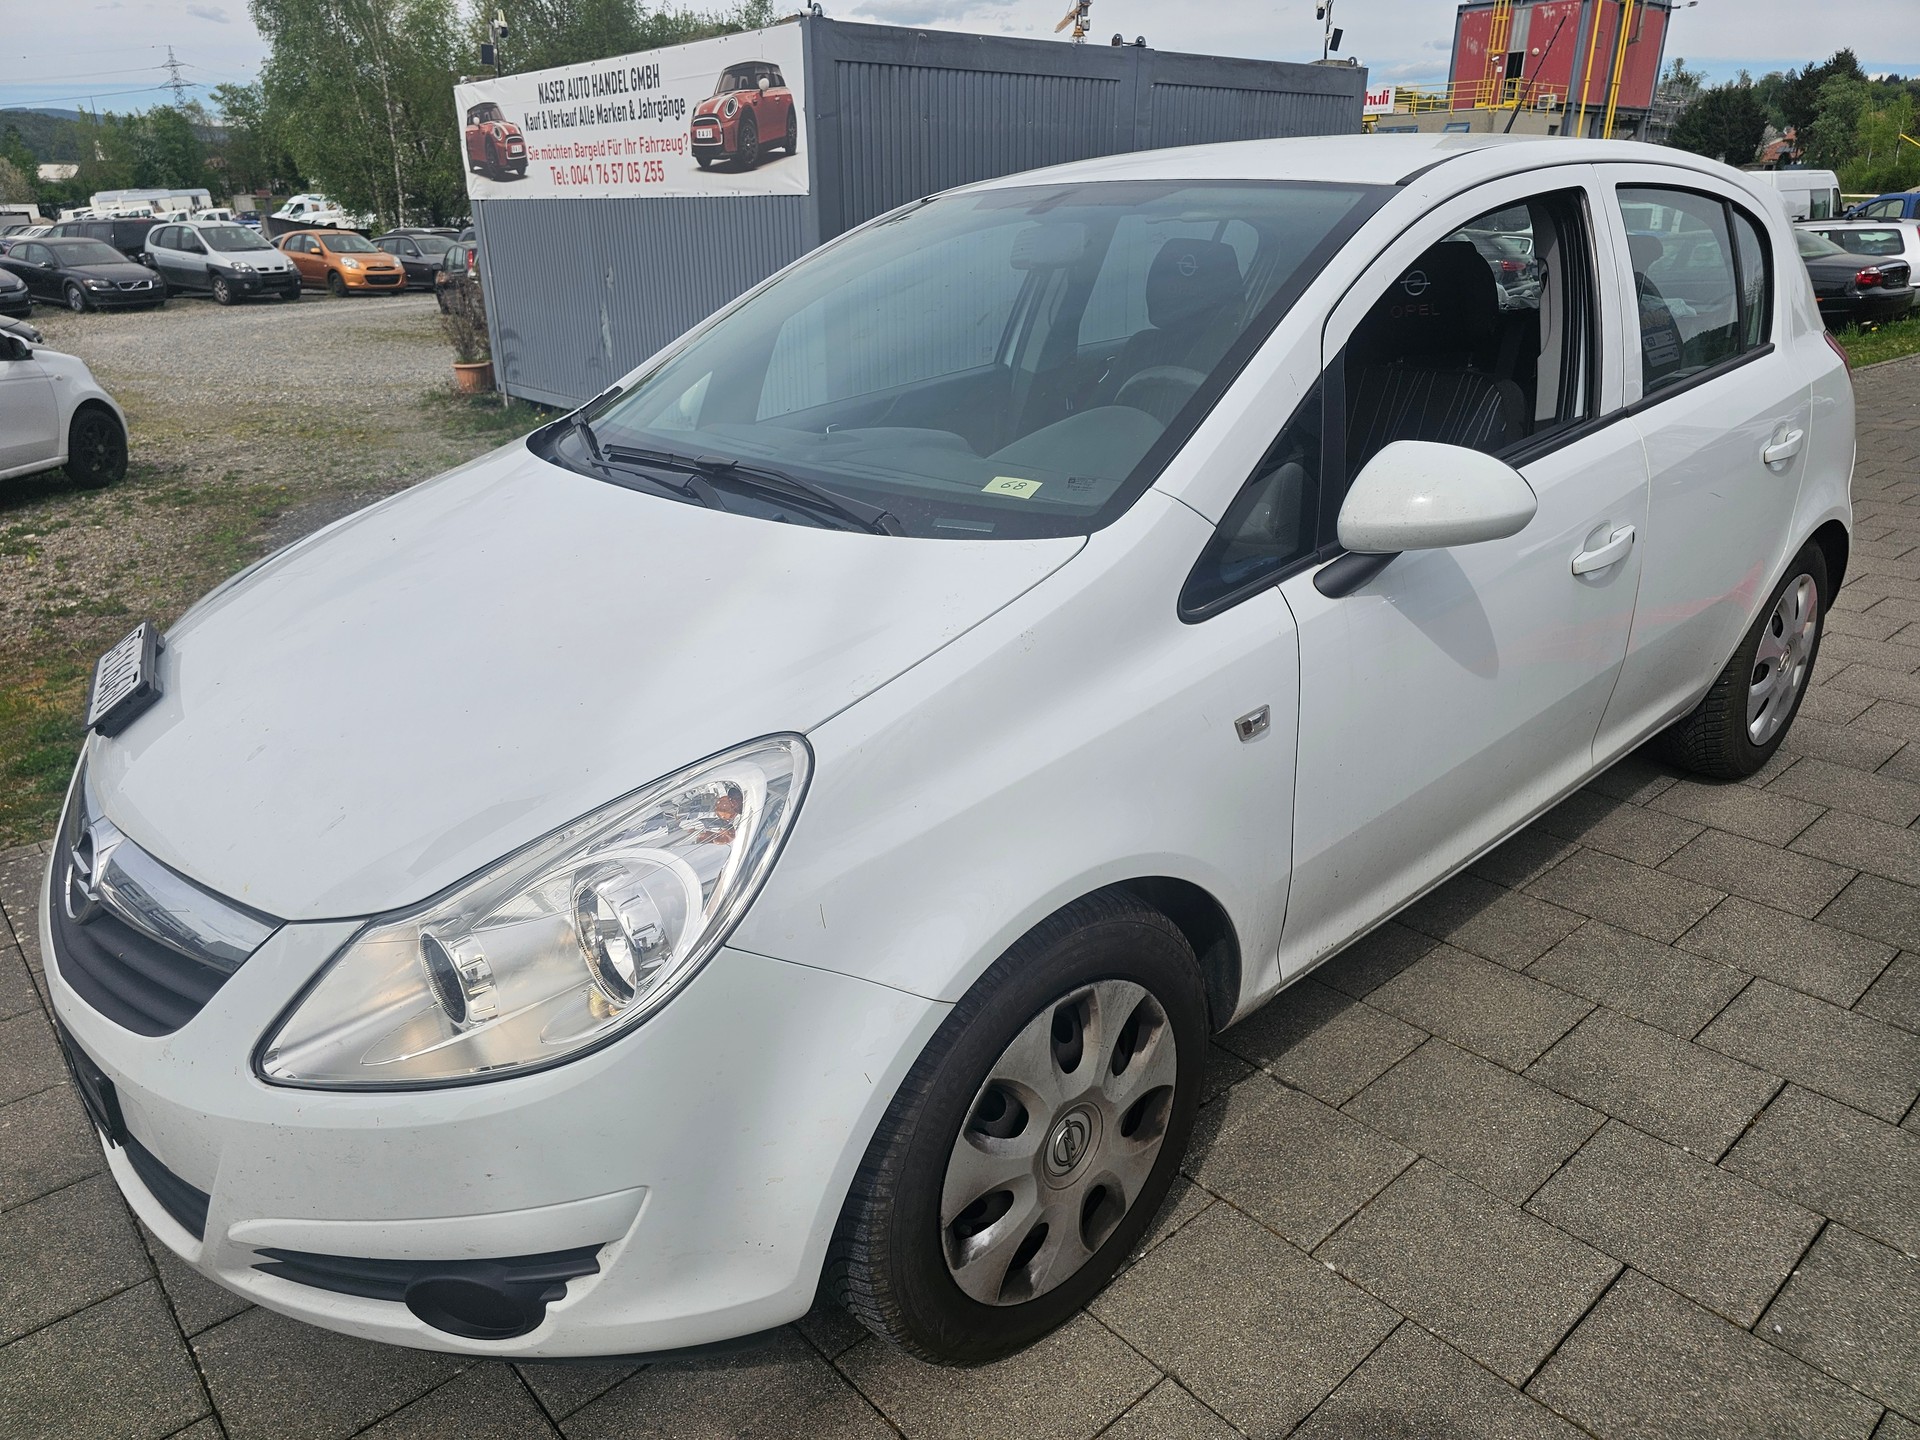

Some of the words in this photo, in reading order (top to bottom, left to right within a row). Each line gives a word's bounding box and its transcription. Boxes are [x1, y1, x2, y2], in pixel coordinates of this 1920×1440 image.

[538, 79, 565, 105] NASER
[567, 75, 590, 101] AUTO
[591, 69, 629, 98] HANDEL
[630, 63, 660, 92] GMBH
[524, 111, 541, 132] Kauf
[542, 111, 548, 130] &
[548, 106, 578, 129] Verkauf
[579, 105, 595, 126] Alle
[596, 102, 627, 125] Marken
[629, 99, 636, 120] &
[638, 94, 686, 123] Jahrgänge
[528, 146, 539, 161] Sie
[541, 143, 573, 161] möchten
[574, 140, 606, 162] Bargeld
[607, 138, 622, 157] Für
[624, 137, 637, 155] Ihr
[639, 132, 689, 156] Fahrzeug?
[550, 166, 569, 186] Tel:
[570, 164, 594, 185] 0041
[596, 163, 609, 184] 76
[611, 162, 624, 184] 57
[627, 161, 641, 183] 05
[643, 160, 665, 183] 255
[1391, 304, 1440, 319] OPEL
[1000, 480, 1028, 491] 68
